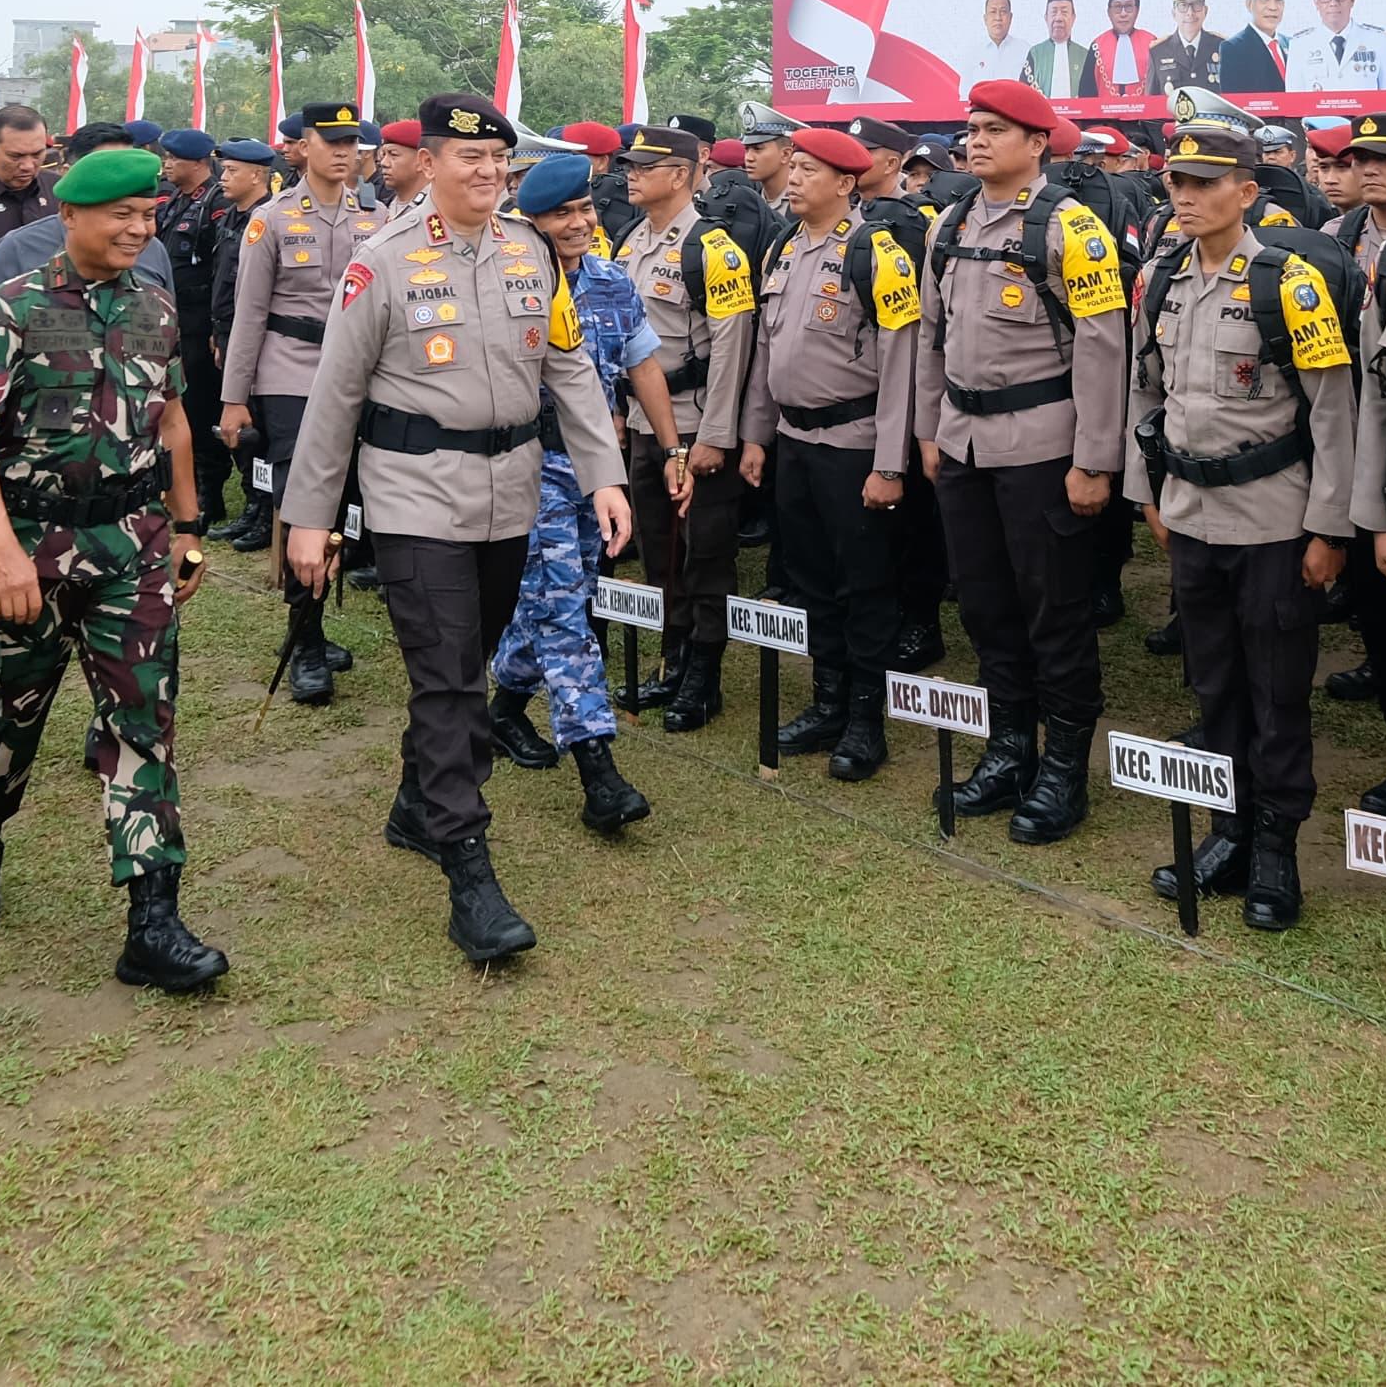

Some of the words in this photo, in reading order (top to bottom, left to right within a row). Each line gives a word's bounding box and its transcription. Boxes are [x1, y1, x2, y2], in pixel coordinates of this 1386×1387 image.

[784, 66, 856, 79] TOGETHER
[784, 80, 797, 90] WE
[798, 79, 815, 89] ARE
[816, 77, 856, 89] STRONG
[1002, 238, 1023, 252] PO
[505, 279, 544, 291] POLRI
[709, 278, 739, 298] PAM
[1066, 271, 1103, 293] PAM
[406, 286, 457, 302] M.IQBAL
[716, 294, 734, 305] OMP
[882, 286, 912, 309] PAM
[1074, 290, 1095, 301] OMP
[1099, 285, 1112, 294] LK
[1087, 297, 1114, 307] POLRES
[1220, 306, 1253, 321] POL
[1293, 321, 1319, 345] AM
[1297, 344, 1315, 358] OMP
[1317, 337, 1333, 348] LK
[1307, 350, 1335, 363] POLRES
[609, 590, 636, 615] KERINCI
[636, 595, 660, 621] KANAN
[730, 605, 754, 633] KEC.
[755, 612, 804, 645] TUALANG
[891, 682, 927, 715] KEC.
[929, 688, 983, 727] DAYUN
[1114, 746, 1156, 784] KEC.
[1160, 755, 1229, 799] MINAS
